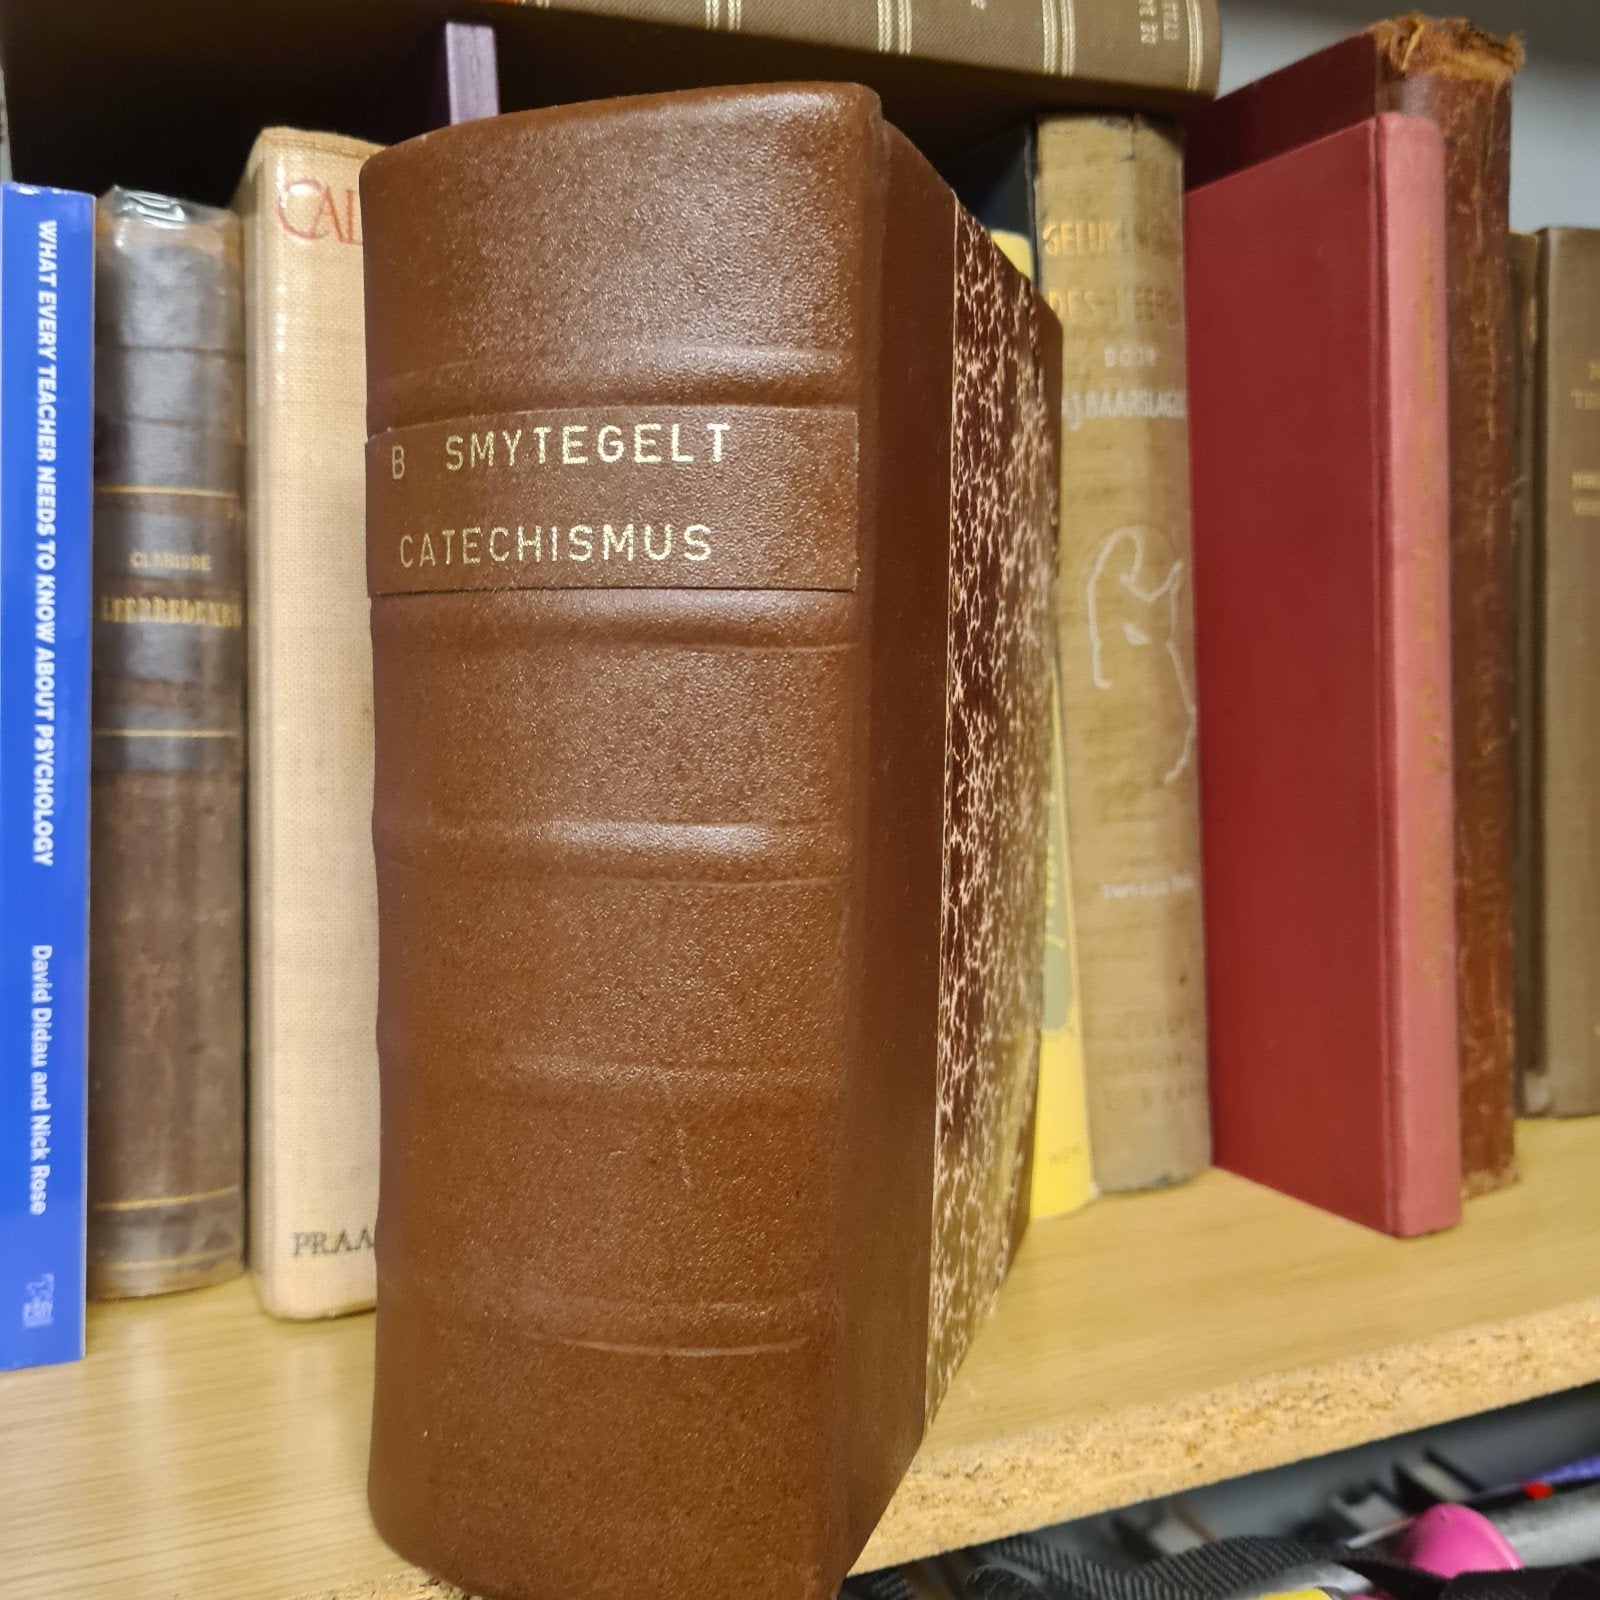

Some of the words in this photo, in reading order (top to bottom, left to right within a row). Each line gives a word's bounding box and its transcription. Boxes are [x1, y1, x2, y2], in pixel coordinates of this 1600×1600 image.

[37, 220, 57, 287] WHAT
[37, 290, 57, 361] EVERY
[36, 364, 57, 462] TEACHER
[391, 445, 406, 480] B
[445, 422, 731, 471] SMYTEGELT
[36, 466, 56, 536] NEEDS
[35, 540, 56, 571] TO
[400, 523, 713, 569] CATECHISMUS
[35, 574, 56, 644] KNOW
[34, 646, 55, 721] ABOUT
[33, 723, 54, 866] PSYCHOLOGY
[31, 944, 53, 1003] David
[31, 1007, 53, 1068] Didau
[31, 1071, 52, 1111] and
[30, 1115, 52, 1162] Nick
[29, 1165, 50, 1216] Rose
